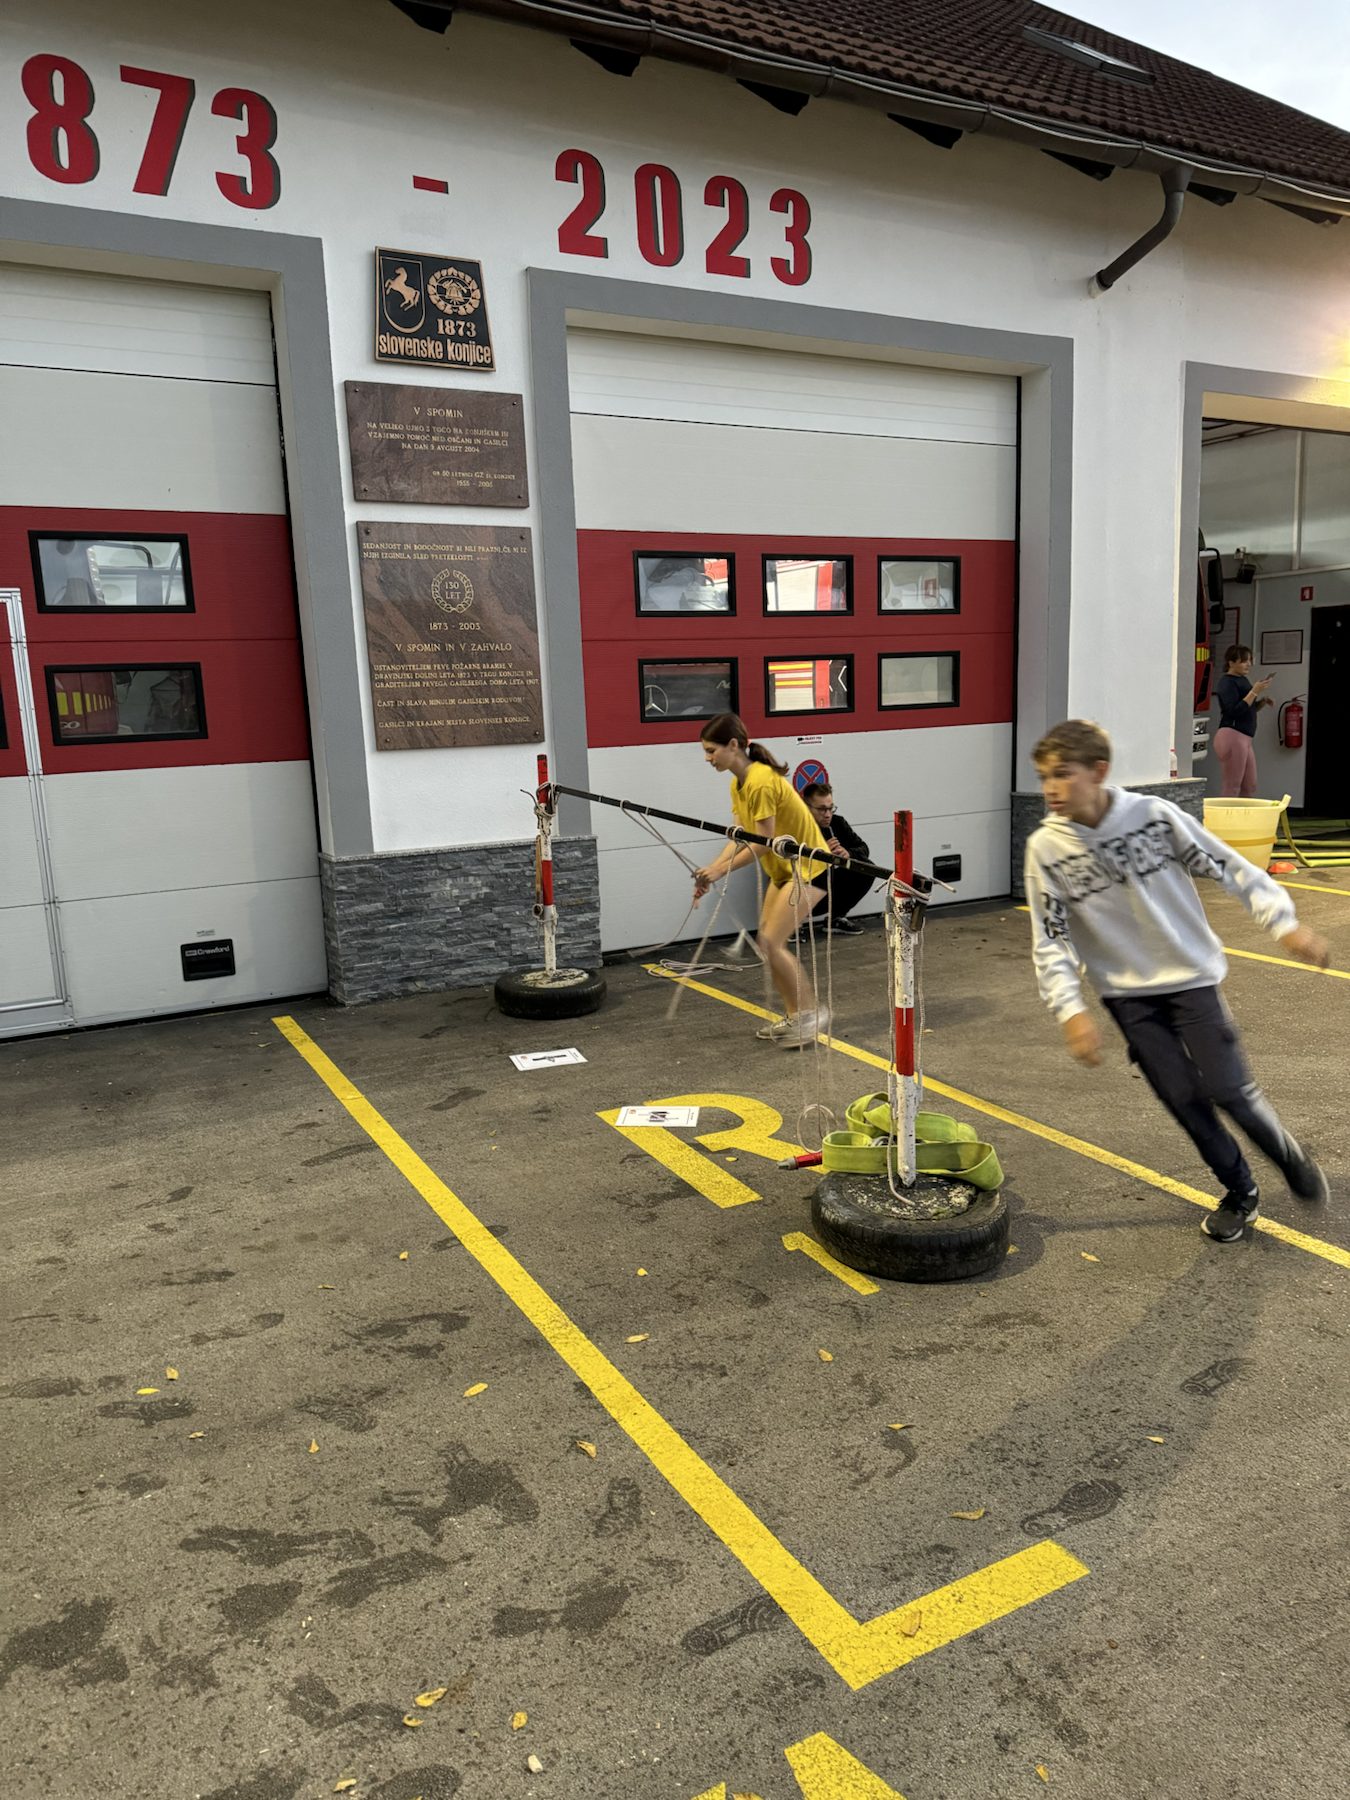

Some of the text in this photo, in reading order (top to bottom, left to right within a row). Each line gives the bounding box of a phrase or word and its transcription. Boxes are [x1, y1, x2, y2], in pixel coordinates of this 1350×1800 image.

[21, 53, 281, 210] 873
[555, 148, 812, 286] 2023
[436, 318, 477, 338] 1873
[379, 332, 492, 366] slovenske konjice
[413, 407, 463, 418] V SPOMIN
[403, 543, 412, 551] IN
[445, 581, 459, 590] 130
[445, 591, 461, 600] LET
[429, 622, 448, 631] 1873
[459, 622, 480, 631] 2003
[395, 643, 512, 652] V SPOMIN IN V ZAHVALO
[407, 699, 427, 707] SLAVA
[407, 720, 415, 728] IN
[197, 945, 230, 956] Crawford
